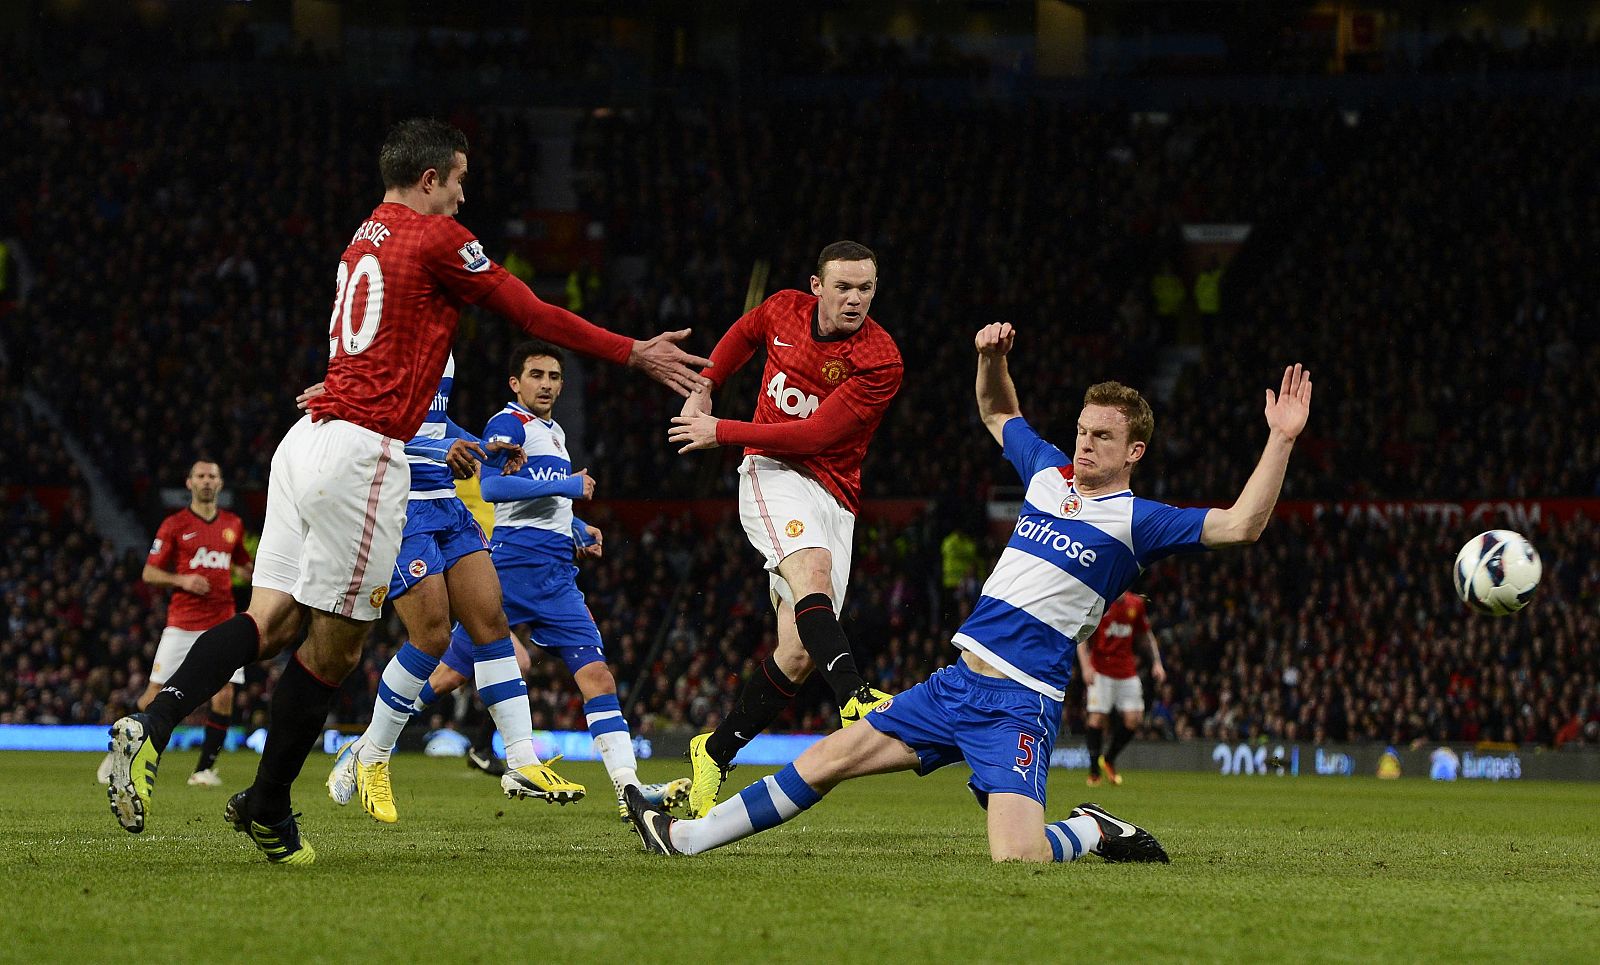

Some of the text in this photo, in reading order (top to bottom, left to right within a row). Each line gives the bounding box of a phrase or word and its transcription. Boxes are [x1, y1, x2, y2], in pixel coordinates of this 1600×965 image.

[351, 220, 391, 248] PERSIE
[329, 254, 384, 359] 20
[1015, 732, 1035, 767] 5
